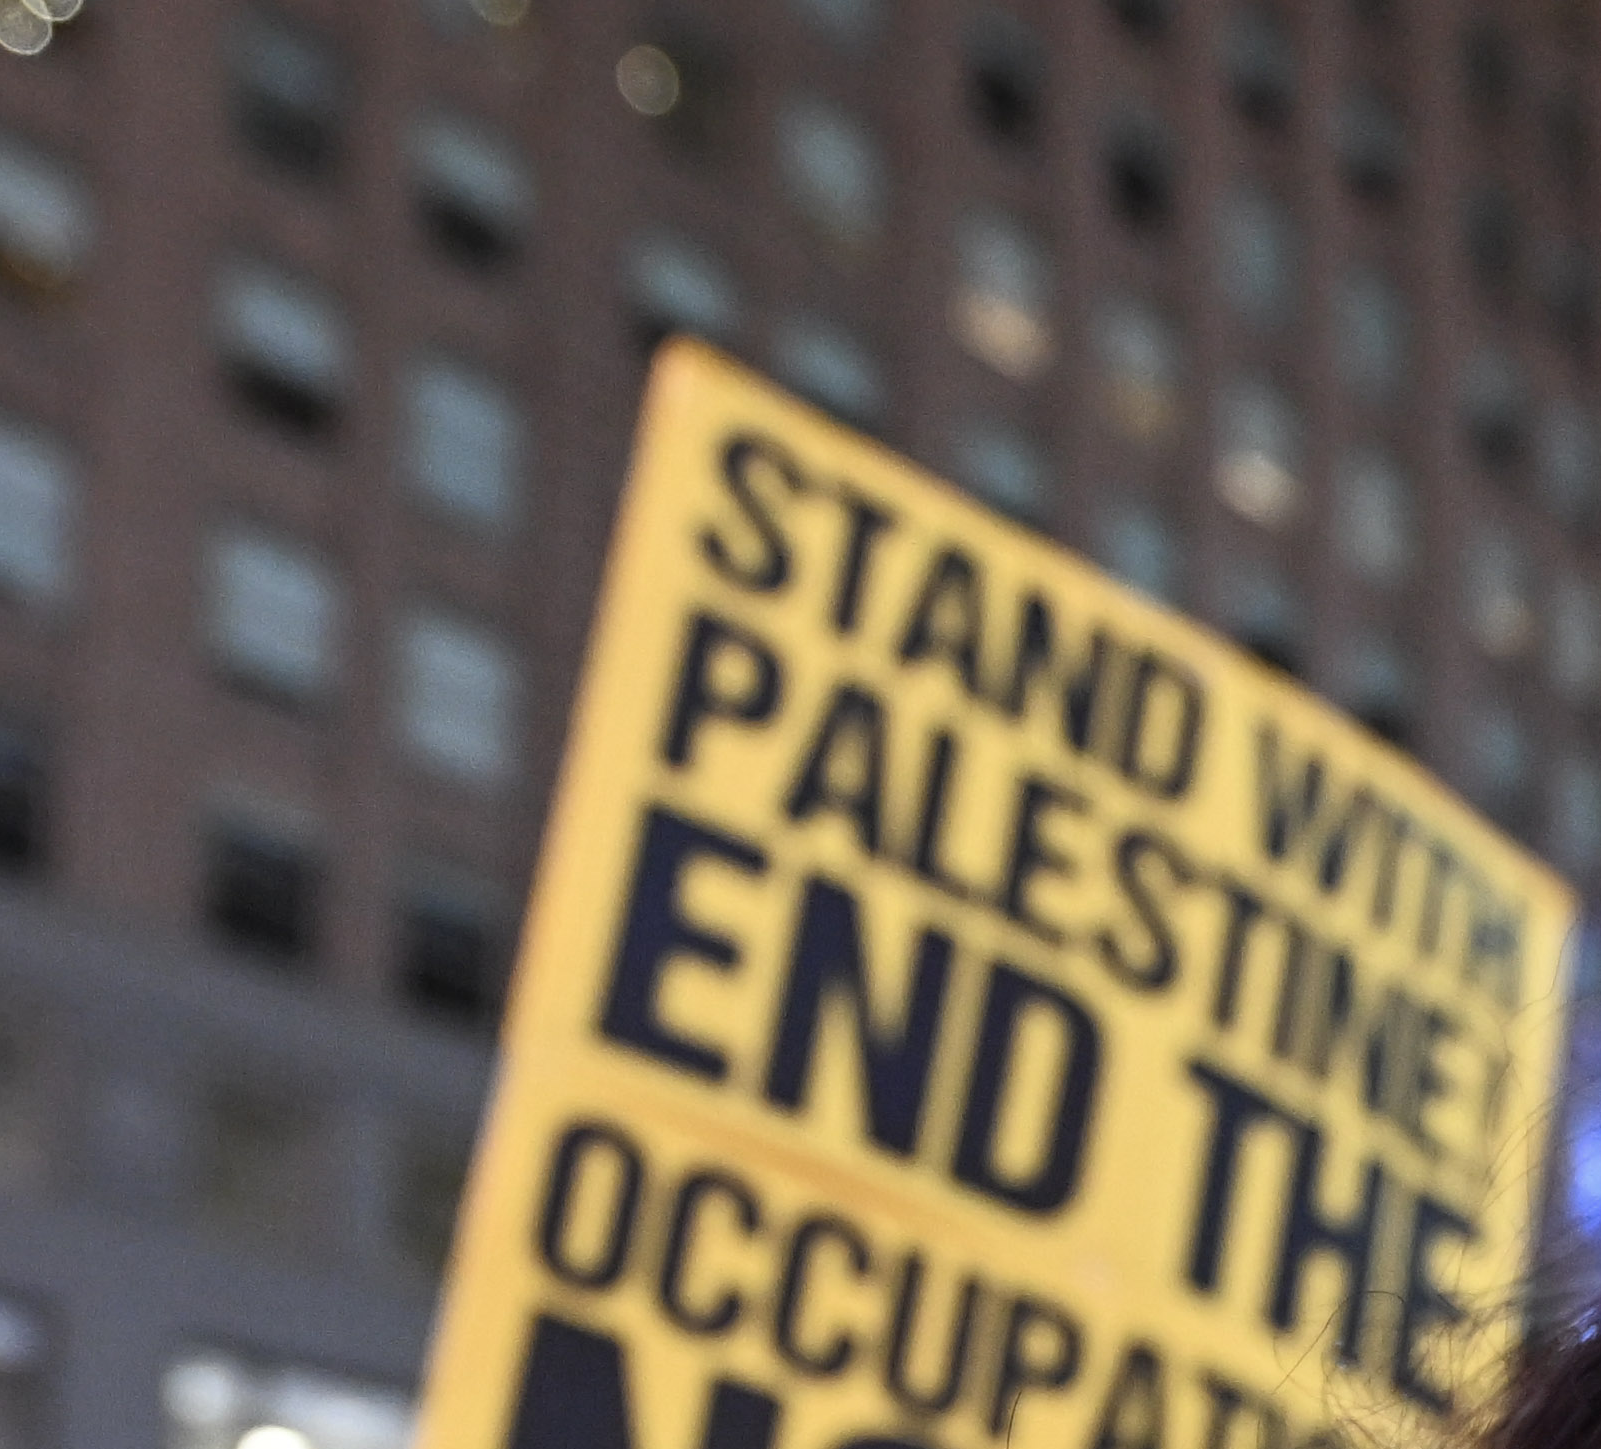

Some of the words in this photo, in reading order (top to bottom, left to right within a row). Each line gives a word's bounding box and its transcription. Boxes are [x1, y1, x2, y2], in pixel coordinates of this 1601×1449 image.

[695, 432, 1205, 803] STAND
[1255, 712, 1527, 1010] WITH
[597, 802, 1107, 1221] END
[1185, 1056, 1479, 1415] THE
